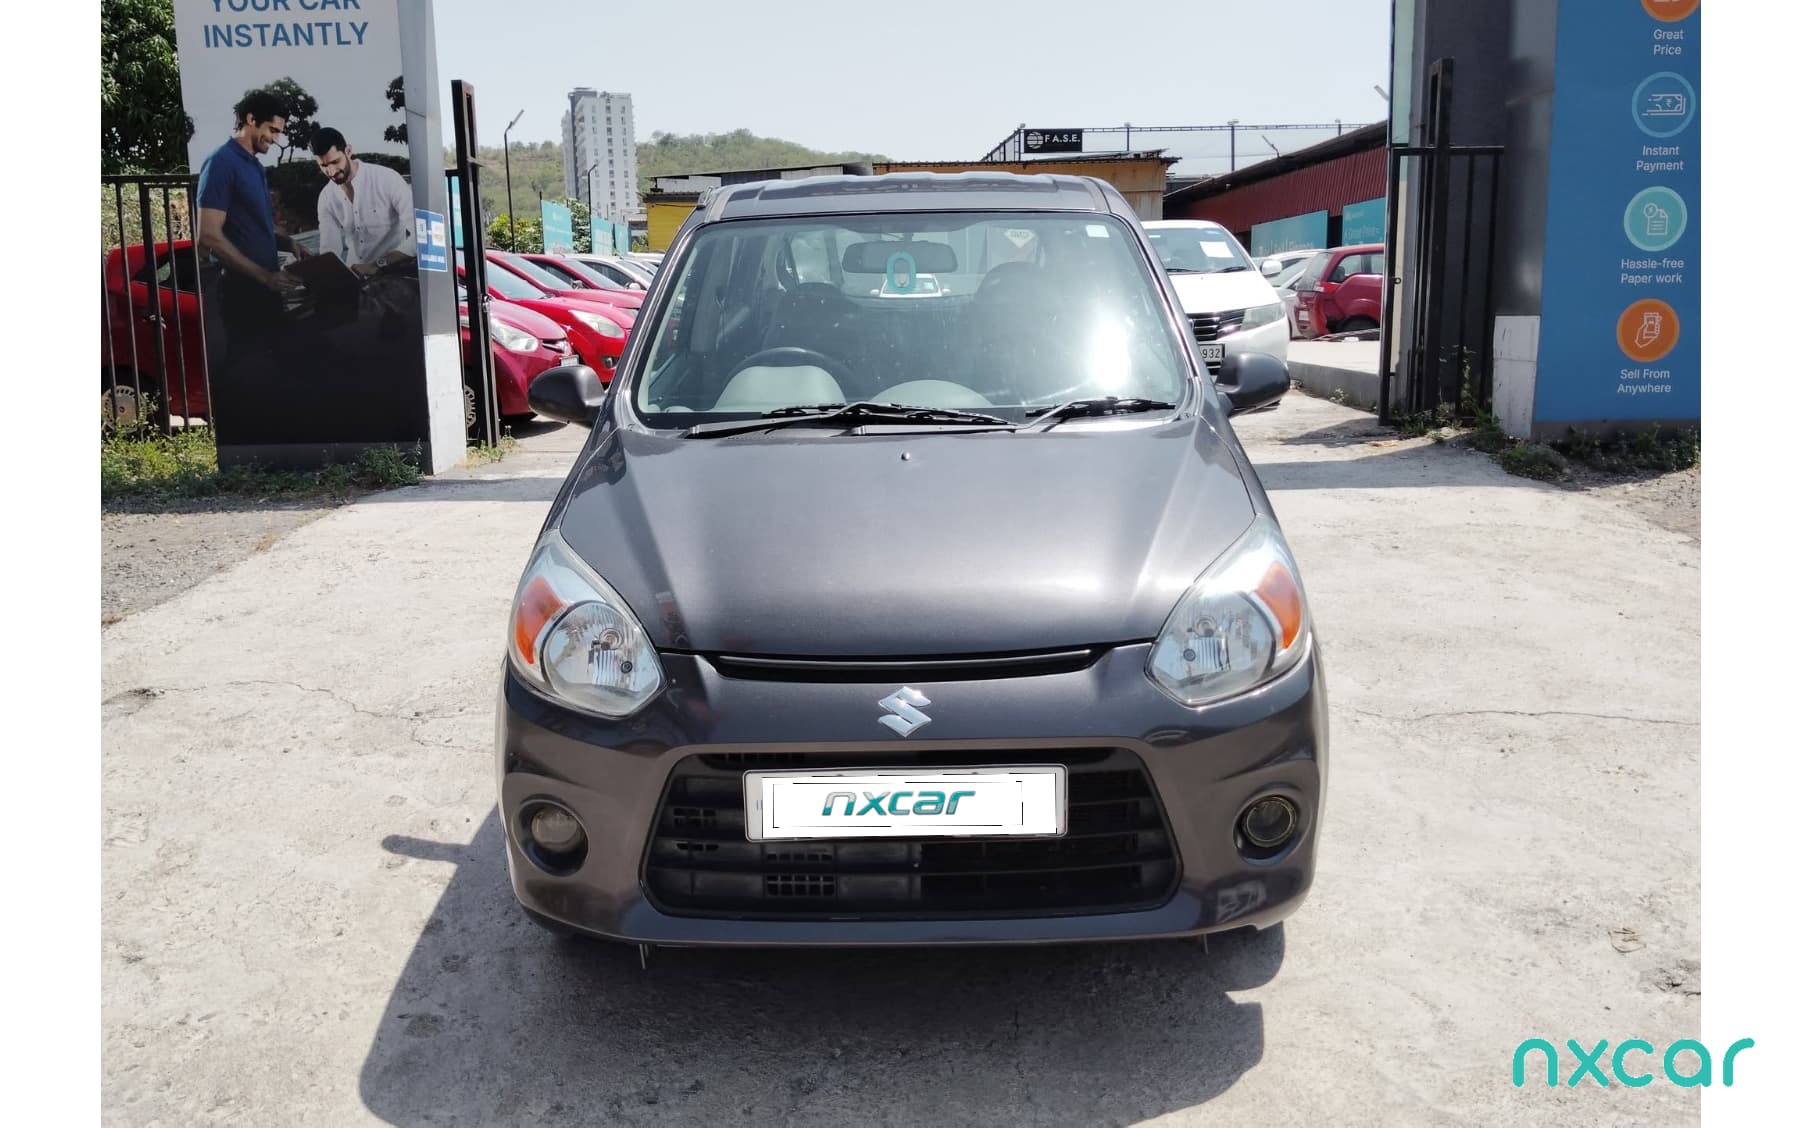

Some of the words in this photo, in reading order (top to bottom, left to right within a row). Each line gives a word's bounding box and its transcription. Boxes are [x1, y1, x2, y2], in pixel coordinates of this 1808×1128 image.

[203, 21, 369, 48] INSTANTLY
[1653, 28, 1684, 41] Great
[1653, 44, 1682, 56] Price
[1642, 145, 1680, 156] Instant
[1636, 160, 1684, 173] Payment
[1621, 257, 1685, 270] Hassle-free
[1621, 273, 1653, 286] Paper
[1655, 272, 1682, 284] work
[1200, 348, 1221, 359] 932
[1620, 368, 1640, 380] Sell
[1643, 368, 1671, 380] From
[1617, 383, 1672, 396] Anywhere
